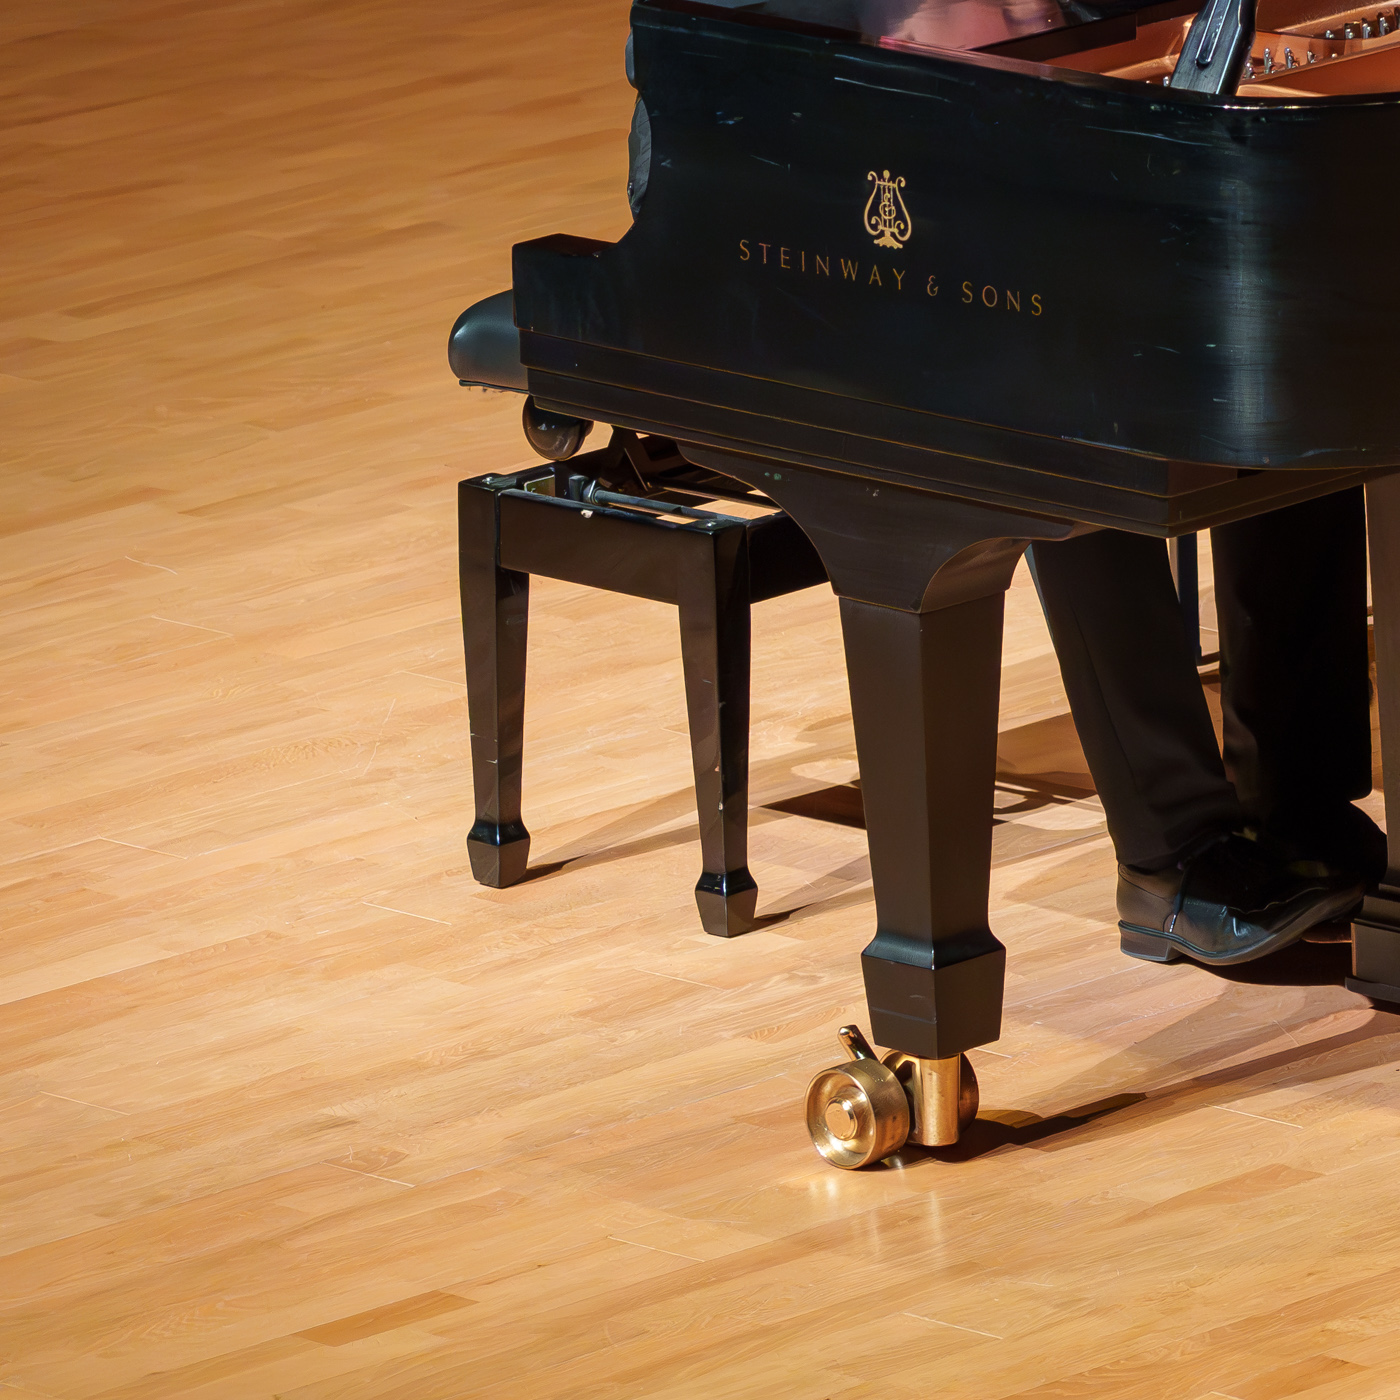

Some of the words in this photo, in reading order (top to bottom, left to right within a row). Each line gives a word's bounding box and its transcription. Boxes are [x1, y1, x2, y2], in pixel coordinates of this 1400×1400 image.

[739, 239, 906, 291] STEINWAY
[926, 274, 939, 297] &
[961, 280, 1043, 316] SONS
